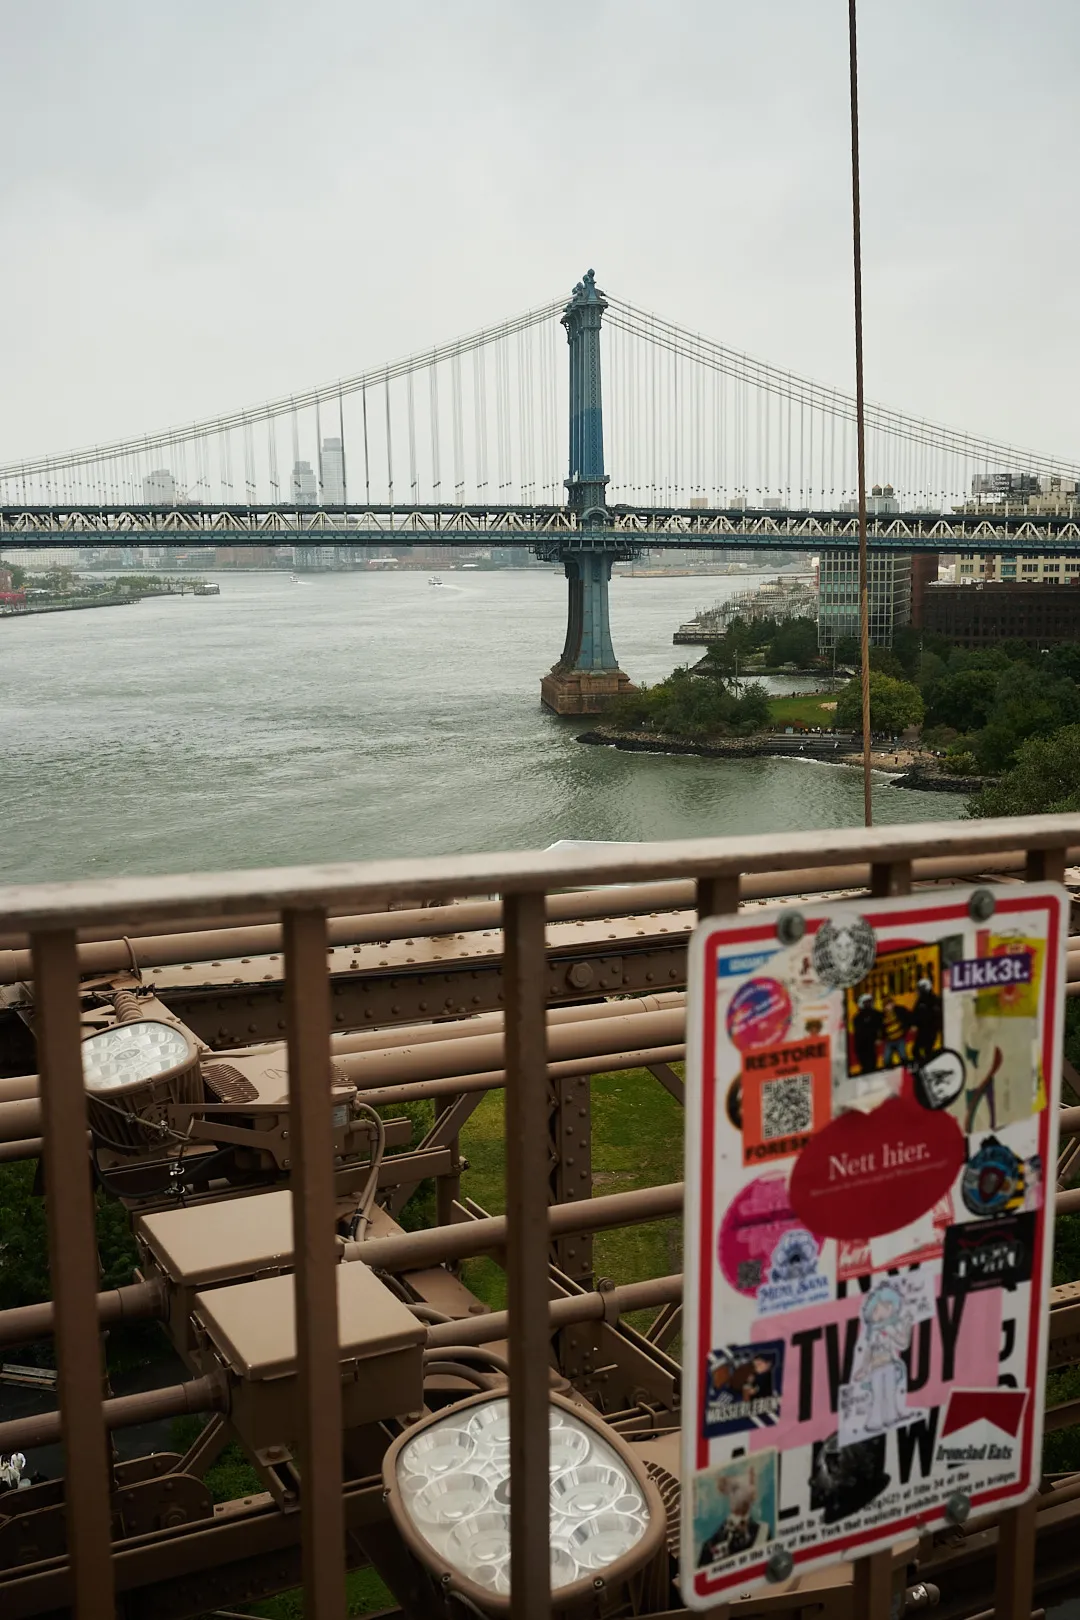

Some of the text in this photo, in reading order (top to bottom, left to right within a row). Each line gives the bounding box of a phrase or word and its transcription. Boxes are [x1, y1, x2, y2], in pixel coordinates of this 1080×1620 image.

[953, 958, 1029, 988] Likk3t.
[745, 1043, 827, 1071] RESTORE
[829, 1153, 875, 1180] Nett
[883, 1141, 931, 1168] hier.
[987, 1443, 1013, 1460] Eats
[957, 1472, 969, 1481] the
[800, 1531, 818, 1544] New
[820, 1523, 841, 1538] York
[844, 1517, 861, 1530] that
[987, 1472, 1016, 1486] bridges
